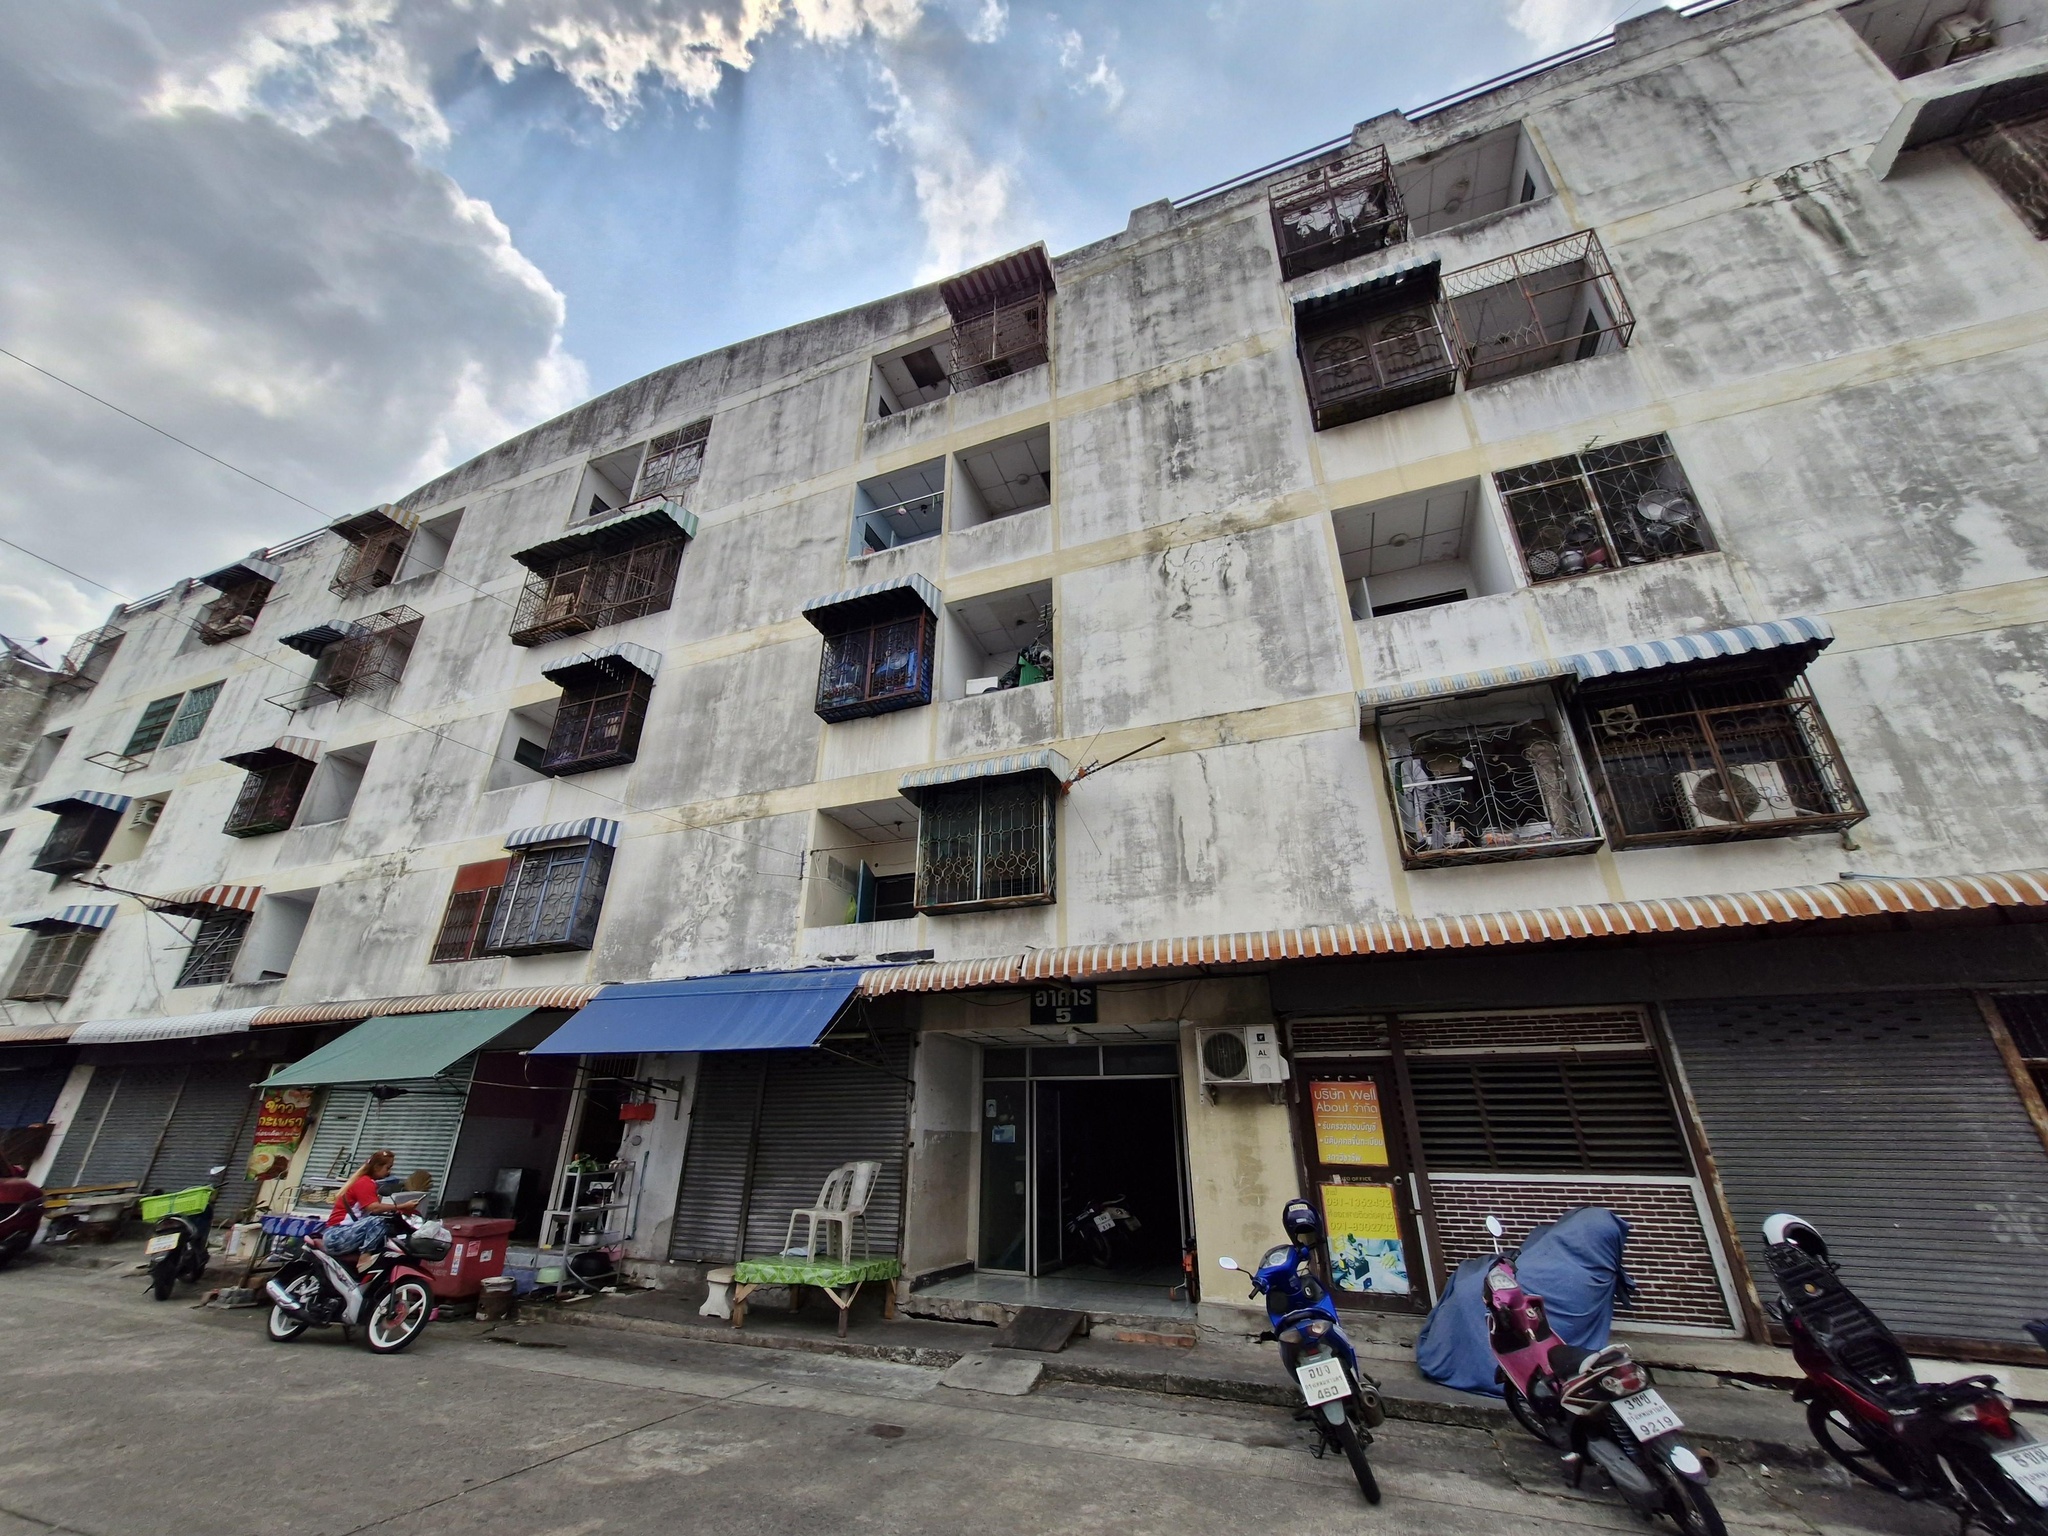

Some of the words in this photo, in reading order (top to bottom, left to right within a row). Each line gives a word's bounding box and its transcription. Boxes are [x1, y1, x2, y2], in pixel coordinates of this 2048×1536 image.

[1035, 988, 1092, 1007] อาคาร
[1055, 1007, 1071, 1023] 5
[1314, 1088, 1346, 1100] บริษัท
[1349, 1088, 1377, 1101] Well
[265, 1097, 295, 1114] ข้าว
[1316, 1101, 1349, 1112] About
[1353, 1102, 1378, 1113] จำกัด
[1640, 1416, 1674, 1436] 9219
